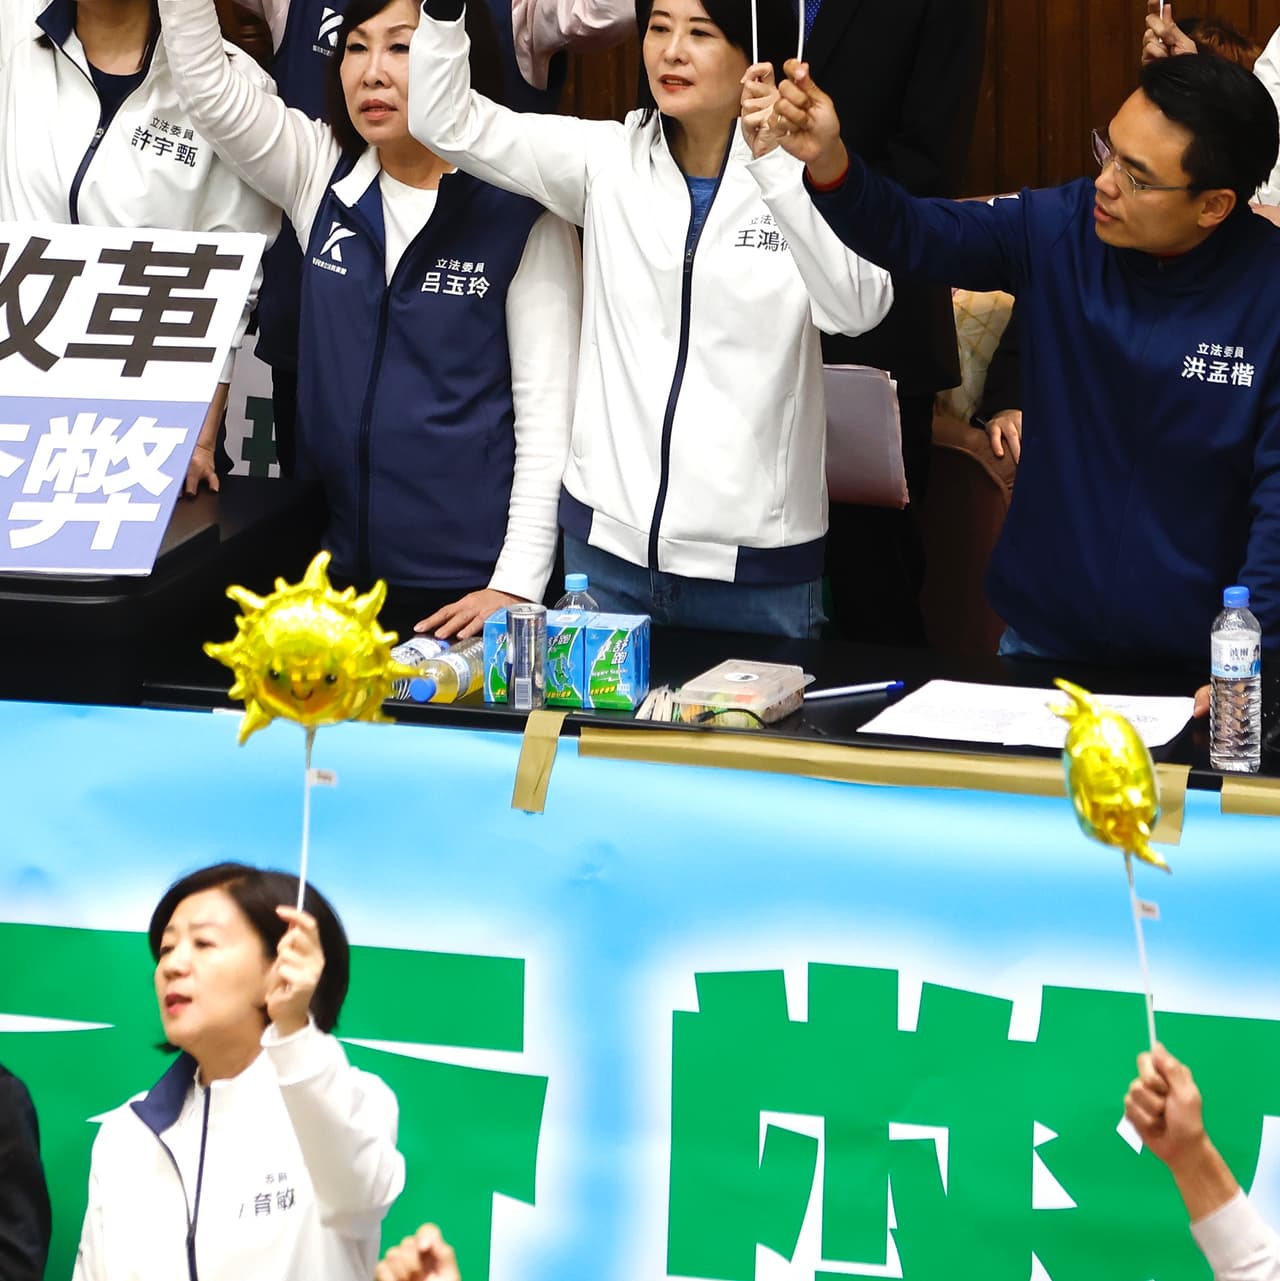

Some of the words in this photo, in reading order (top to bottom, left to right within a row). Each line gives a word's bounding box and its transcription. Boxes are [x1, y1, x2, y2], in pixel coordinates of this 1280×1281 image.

[150, 116, 195, 141] 立法委員
[131, 125, 199, 168] 許宇甄
[434, 258, 486, 274] 立法委員
[421, 272, 491, 299] 呂玉玲
[1196, 342, 1245, 359] 立法委員
[1181, 355, 1255, 388] 洪孟楷
[239, 1186, 296, 1219] 育敏
